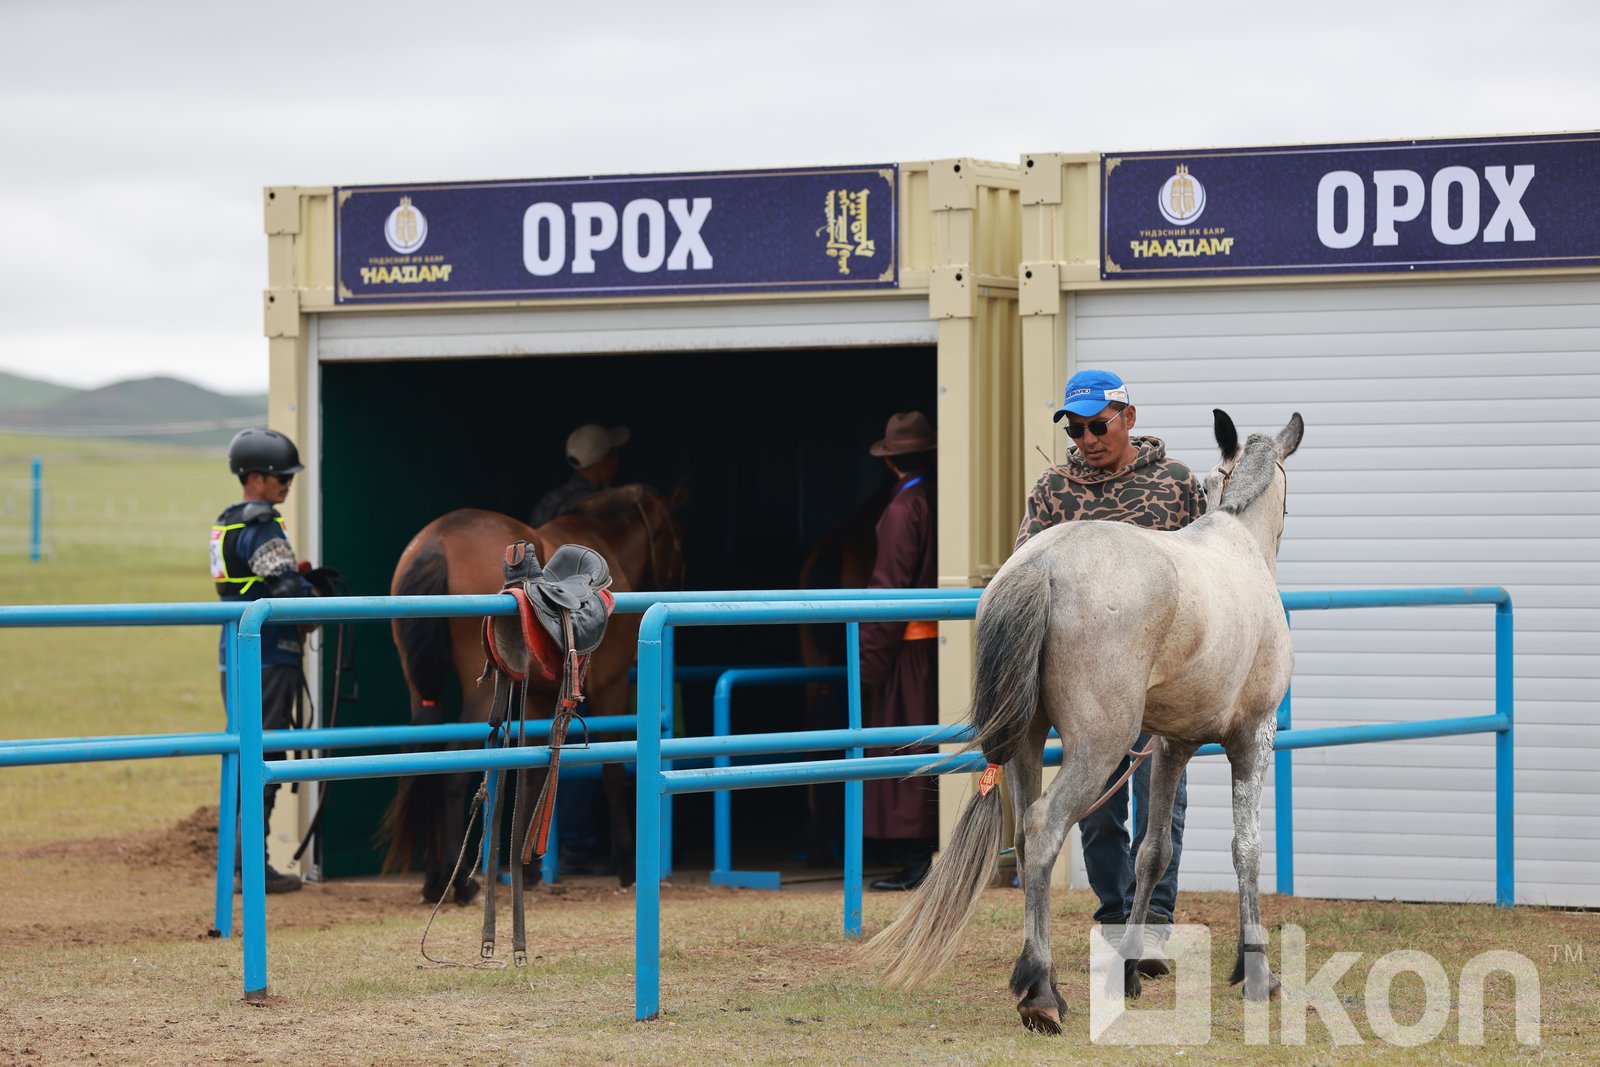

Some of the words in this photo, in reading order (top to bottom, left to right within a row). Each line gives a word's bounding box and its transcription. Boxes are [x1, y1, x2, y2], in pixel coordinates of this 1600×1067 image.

[1317, 164, 1536, 249] ОРОХ
[523, 197, 714, 276] ОРОХ
[1130, 237, 1234, 258] НААДАМ
[360, 264, 452, 285] НААДАМ
